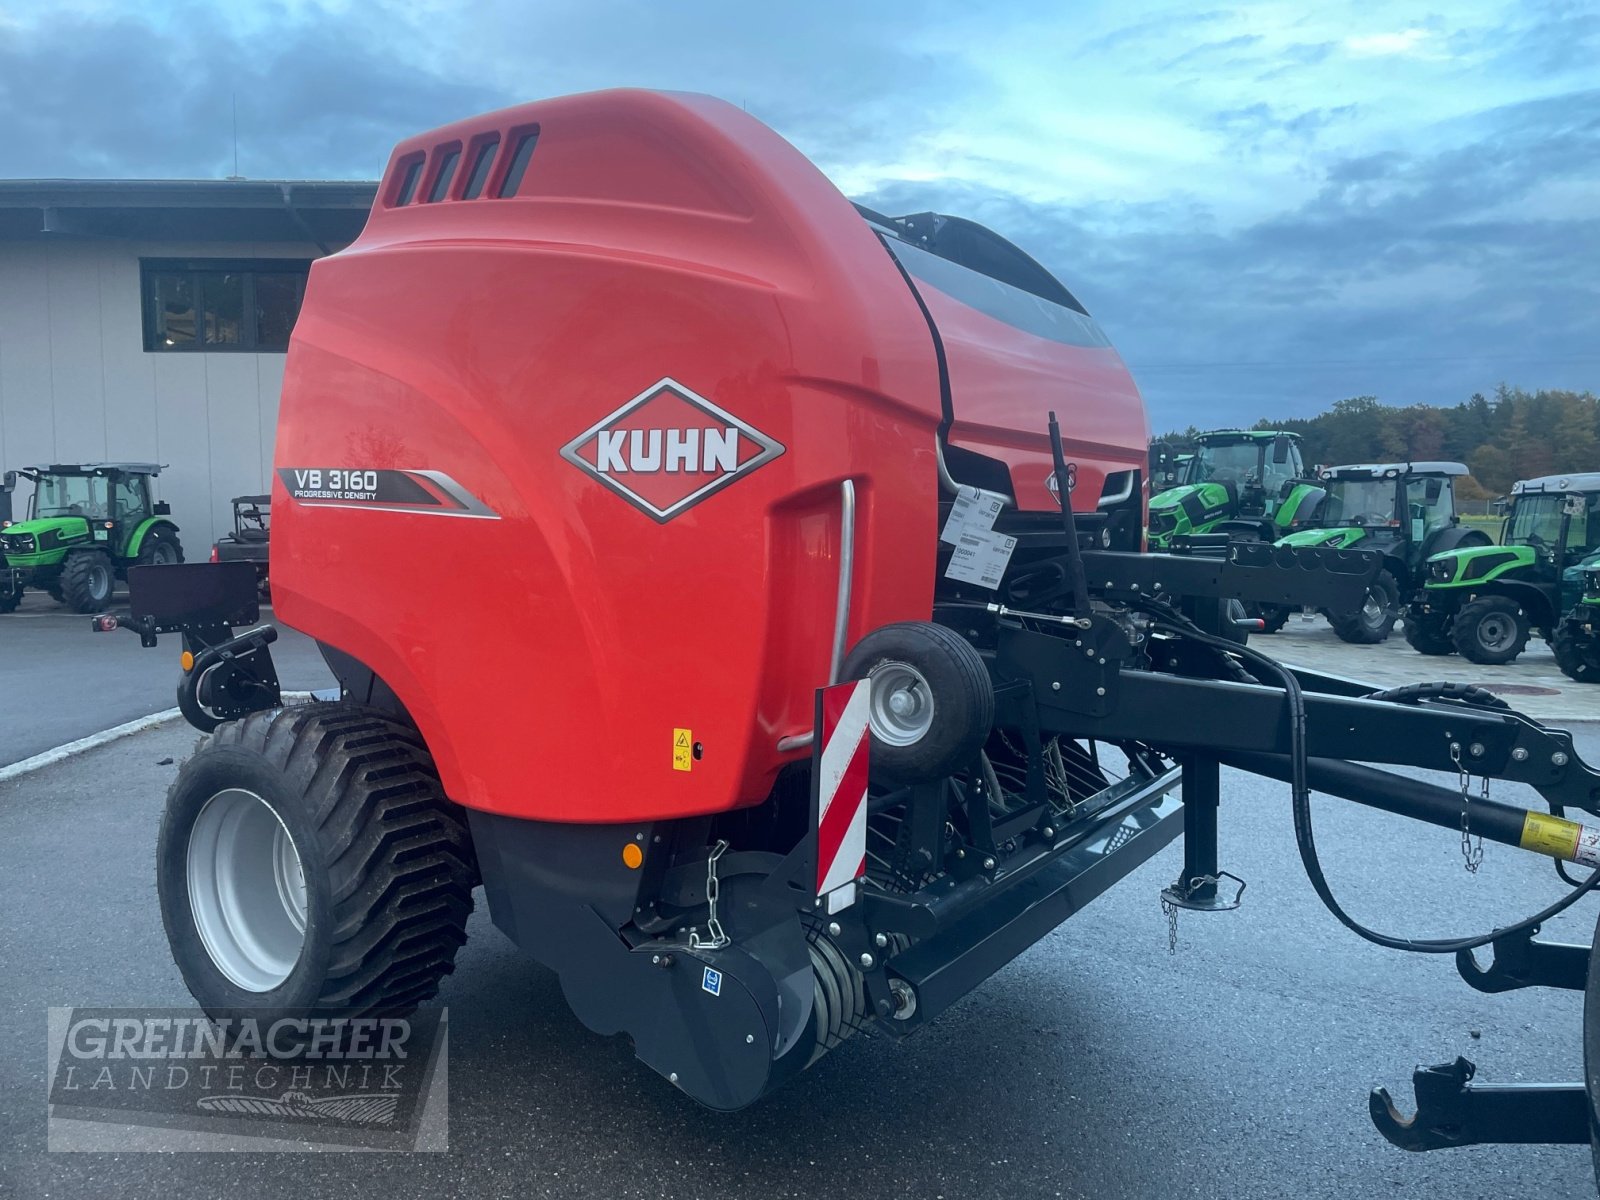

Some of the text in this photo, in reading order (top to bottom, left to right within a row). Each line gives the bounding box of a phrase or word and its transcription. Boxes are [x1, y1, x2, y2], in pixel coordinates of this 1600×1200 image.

[597, 427, 739, 473] KUHN
[294, 469, 378, 491] VB 3160
[294, 490, 377, 500] PROGRESSIVE DENSITY
